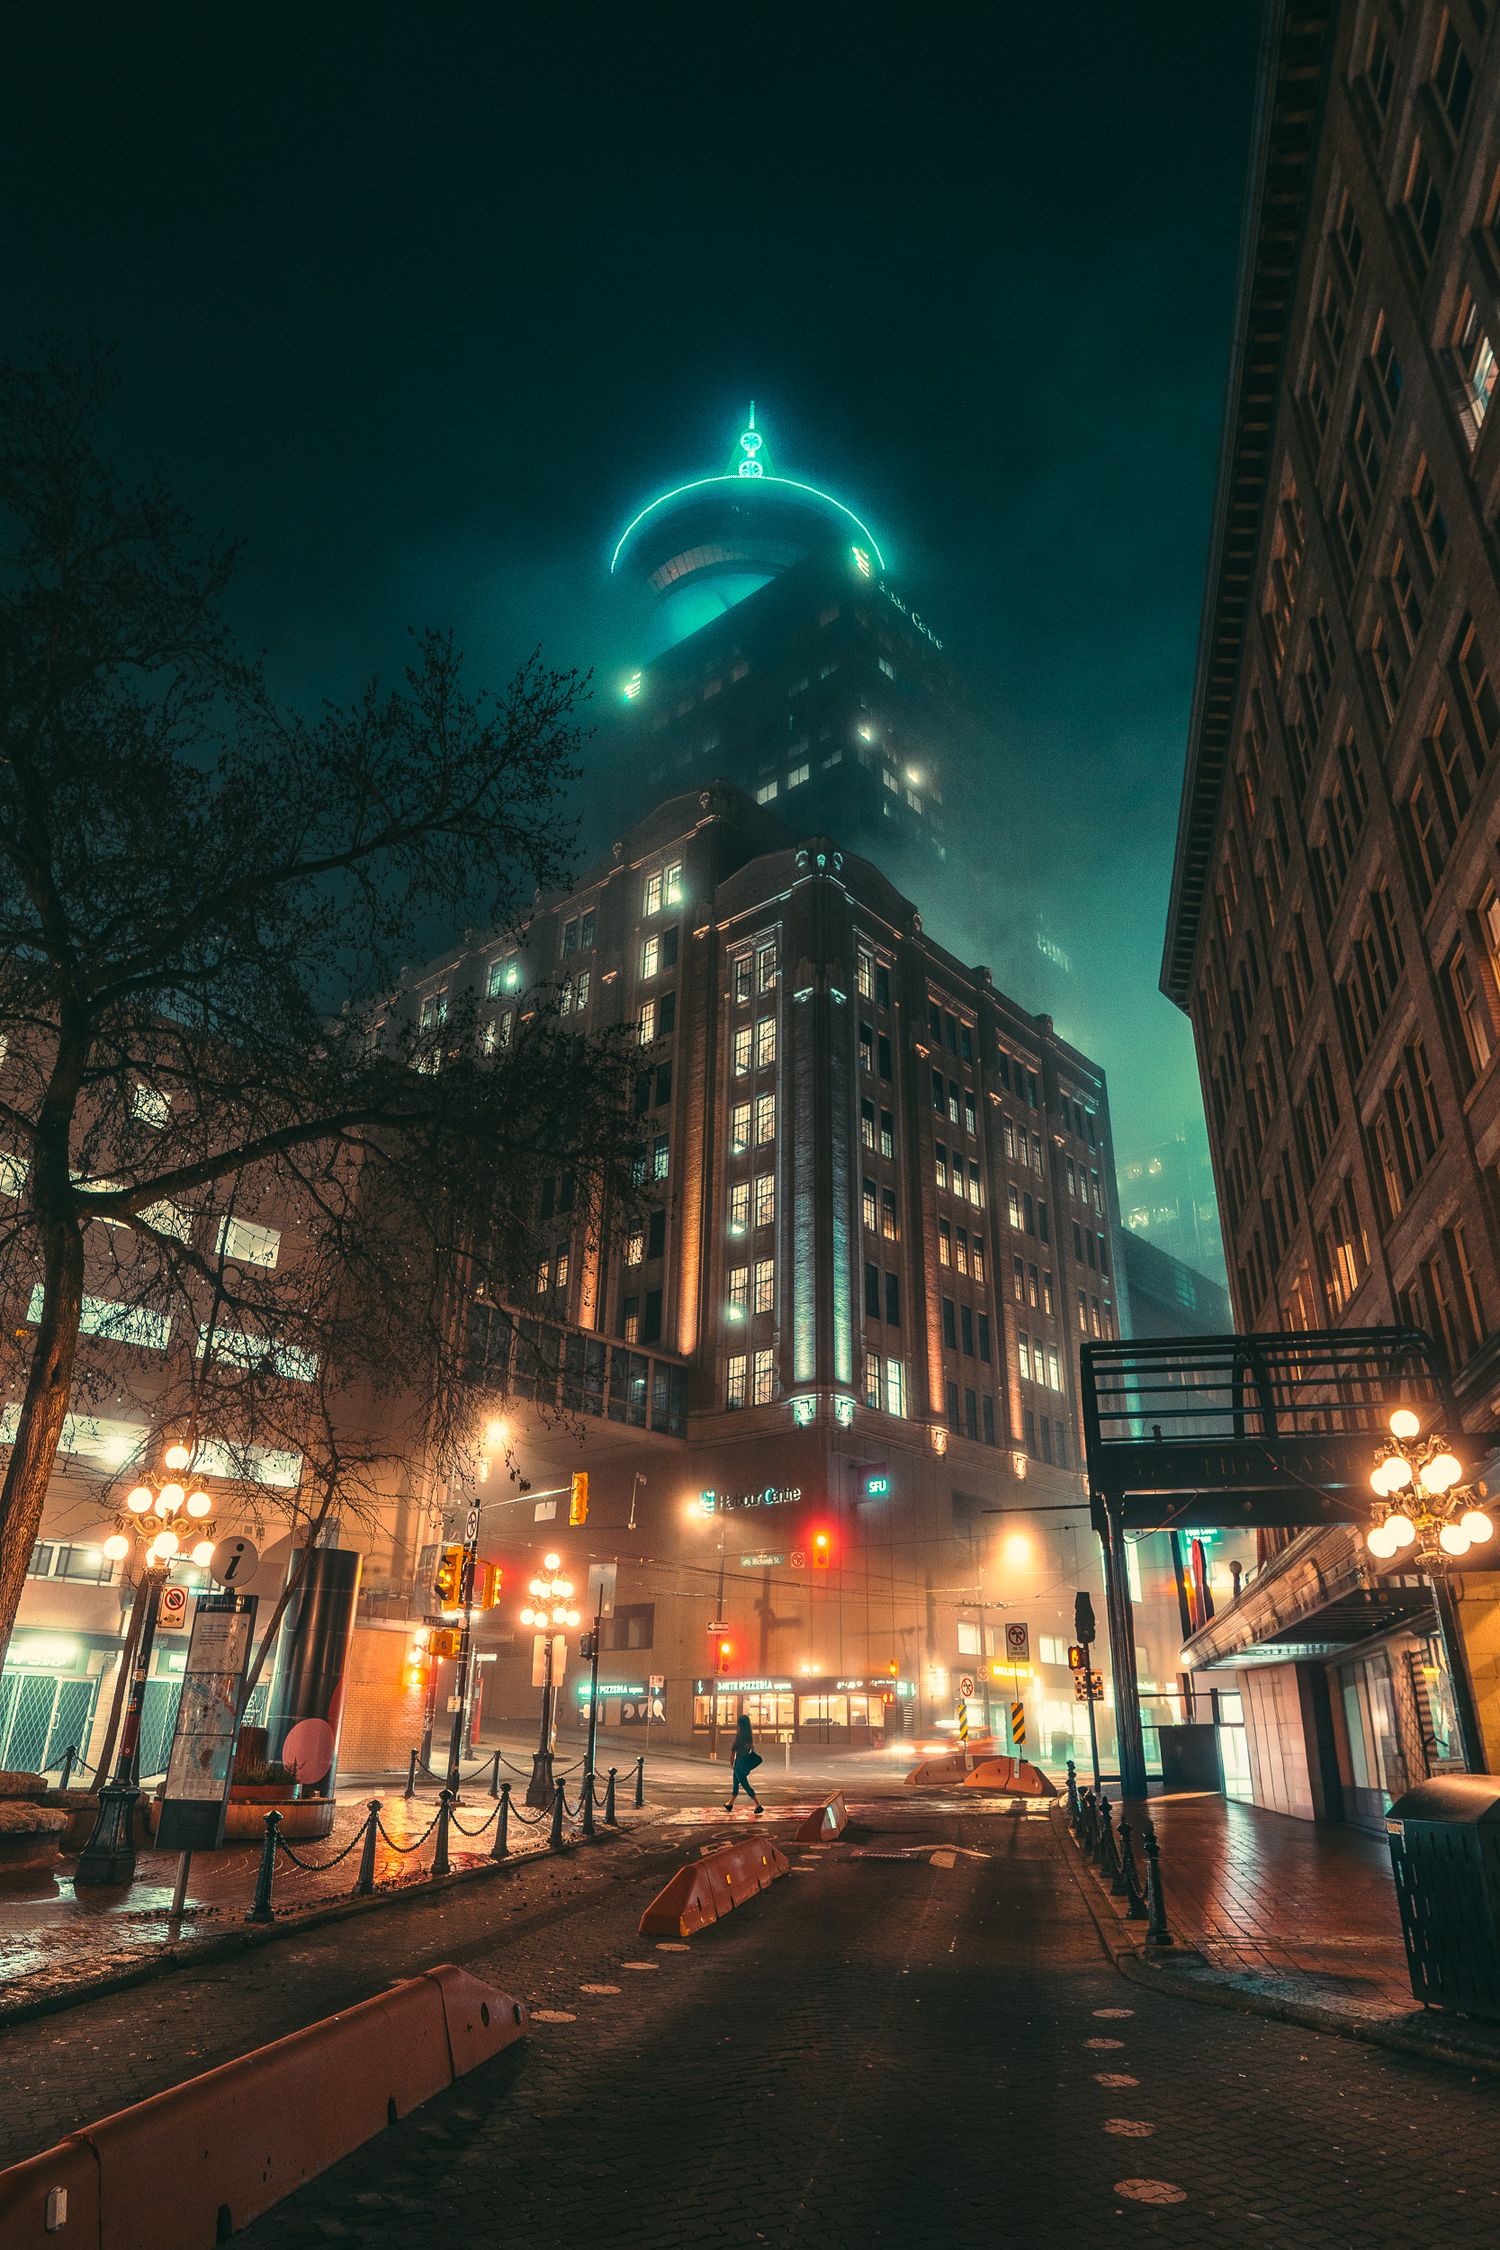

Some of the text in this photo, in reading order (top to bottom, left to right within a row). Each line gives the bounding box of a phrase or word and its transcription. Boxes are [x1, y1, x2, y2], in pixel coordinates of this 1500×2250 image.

[1282, 1452, 1364, 1472] LAND
[869, 1480, 887, 1493] SFU
[763, 1487, 802, 1505] Centre
[752, 1556, 773, 1566] Richards
[599, 1684, 628, 1694] PIZZERIA
[738, 1680, 773, 1690] PIZZERIA
